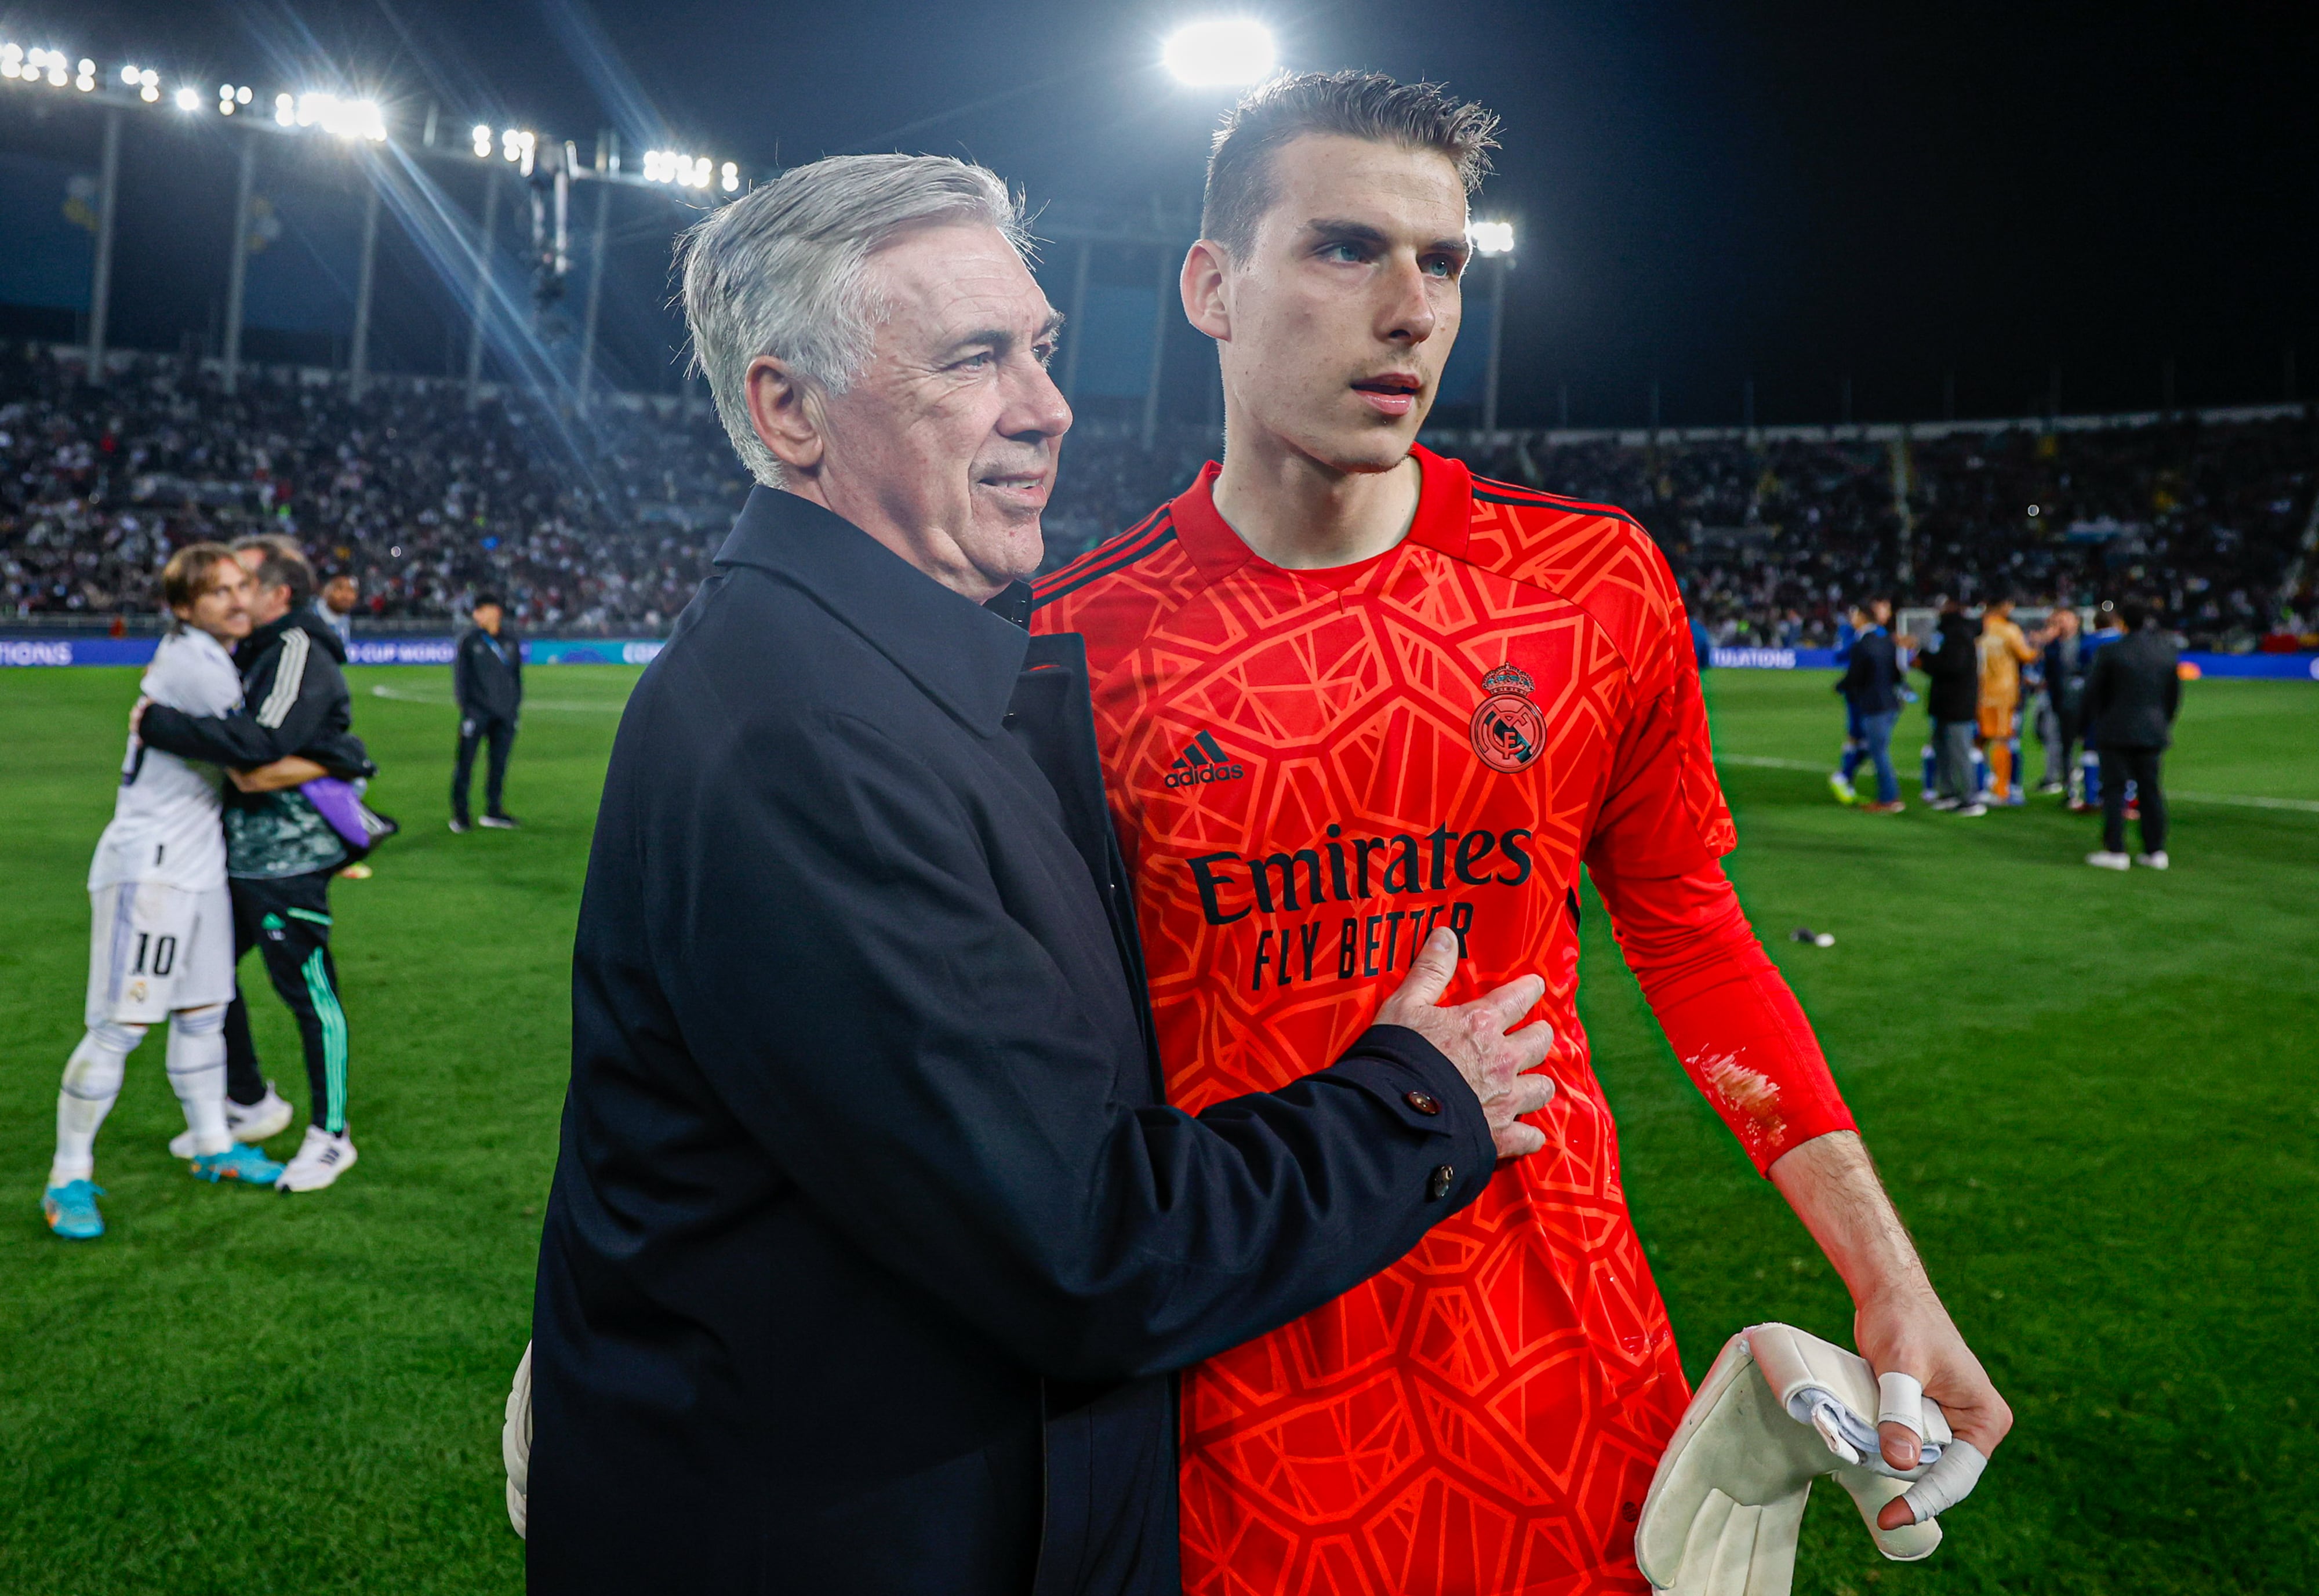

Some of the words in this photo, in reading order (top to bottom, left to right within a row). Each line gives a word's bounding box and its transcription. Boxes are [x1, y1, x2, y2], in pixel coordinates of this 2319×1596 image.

[361, 643, 395, 663] CUP
[1165, 762, 1244, 788] adidas
[1187, 821, 1531, 925] Emirates
[129, 933, 176, 975] 10
[1252, 918, 1321, 991] FLY
